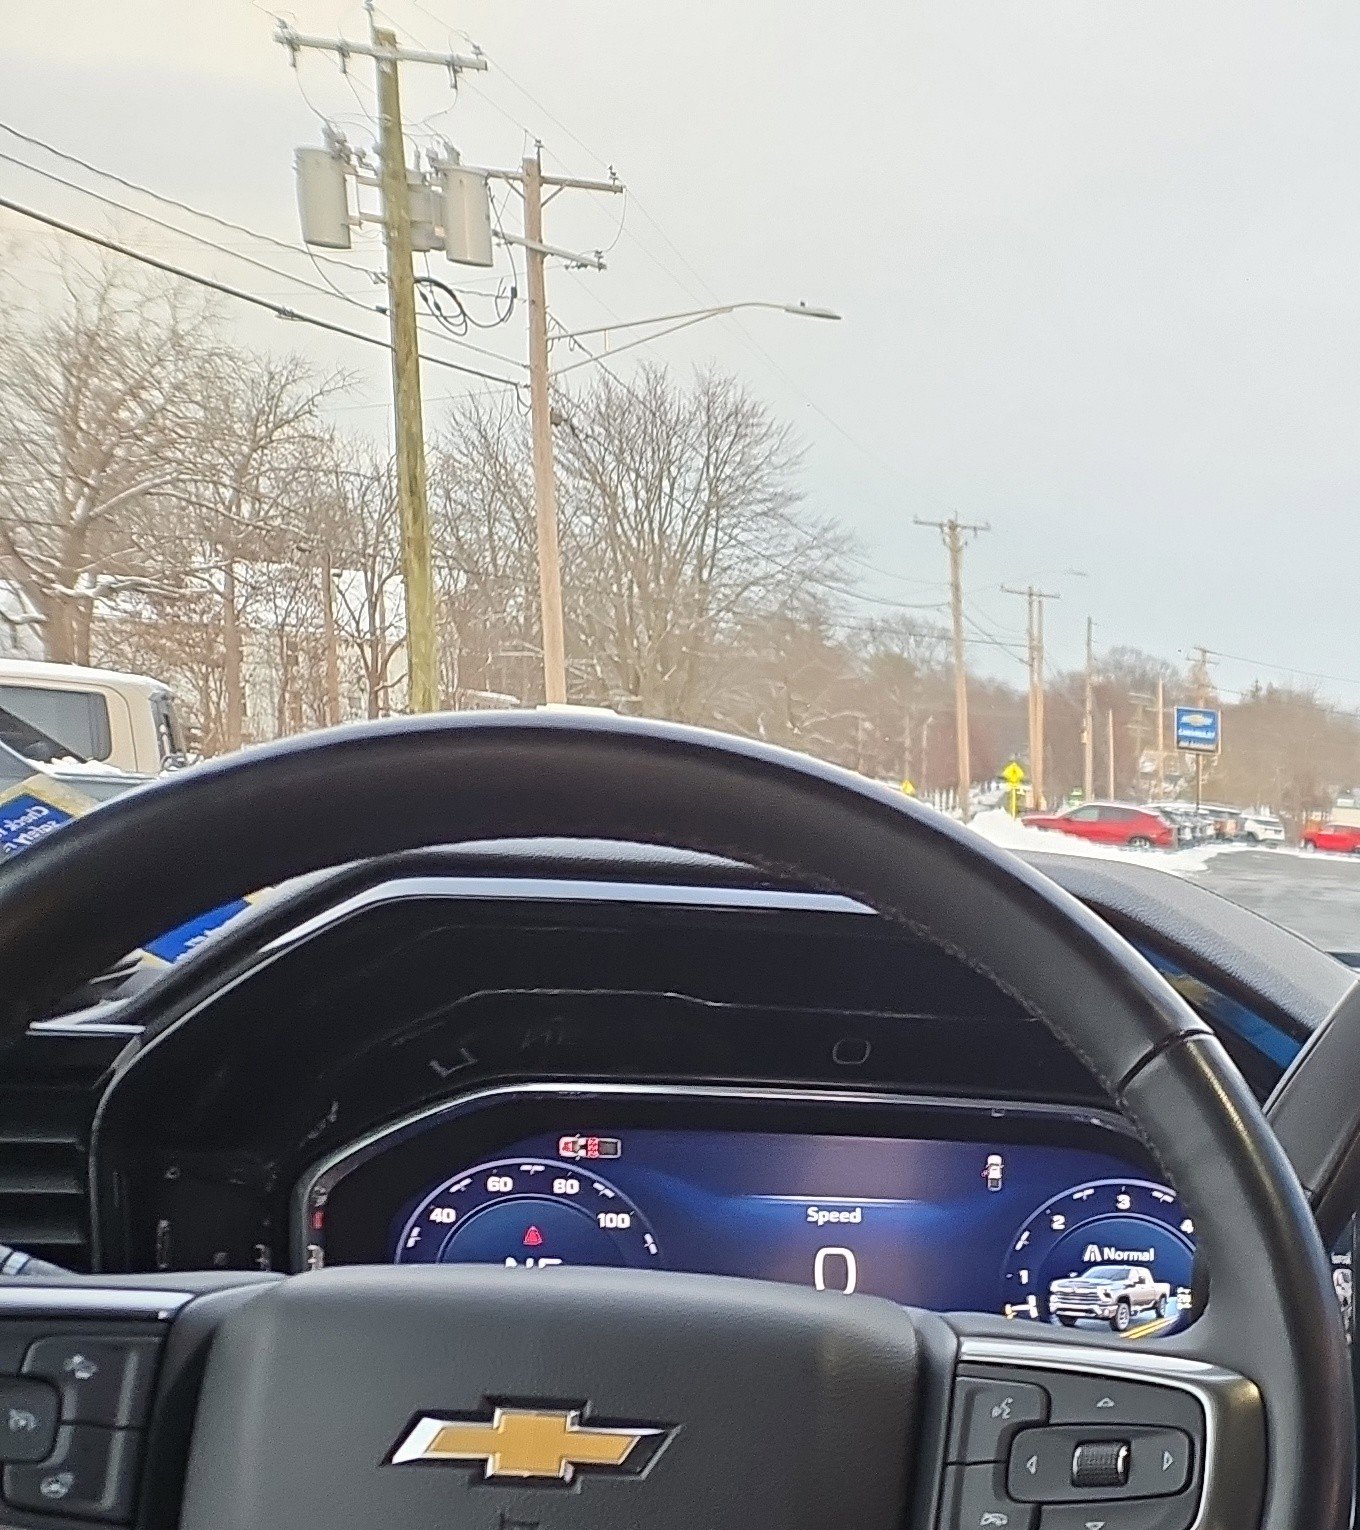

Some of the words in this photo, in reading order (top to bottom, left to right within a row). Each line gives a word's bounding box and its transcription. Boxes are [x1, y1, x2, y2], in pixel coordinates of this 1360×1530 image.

[486, 1176, 514, 1193] 60
[552, 1178, 580, 1195] 80
[1116, 1194, 1131, 1210] 3
[429, 1207, 457, 1224] 40
[597, 1213, 631, 1229] 100
[806, 1206, 862, 1227] Speed
[1051, 1214, 1066, 1230] 2
[1179, 1218, 1195, 1234] 4
[1103, 1246, 1156, 1262] Normal
[814, 1247, 857, 1295] 0
[1018, 1268, 1029, 1285] 1
